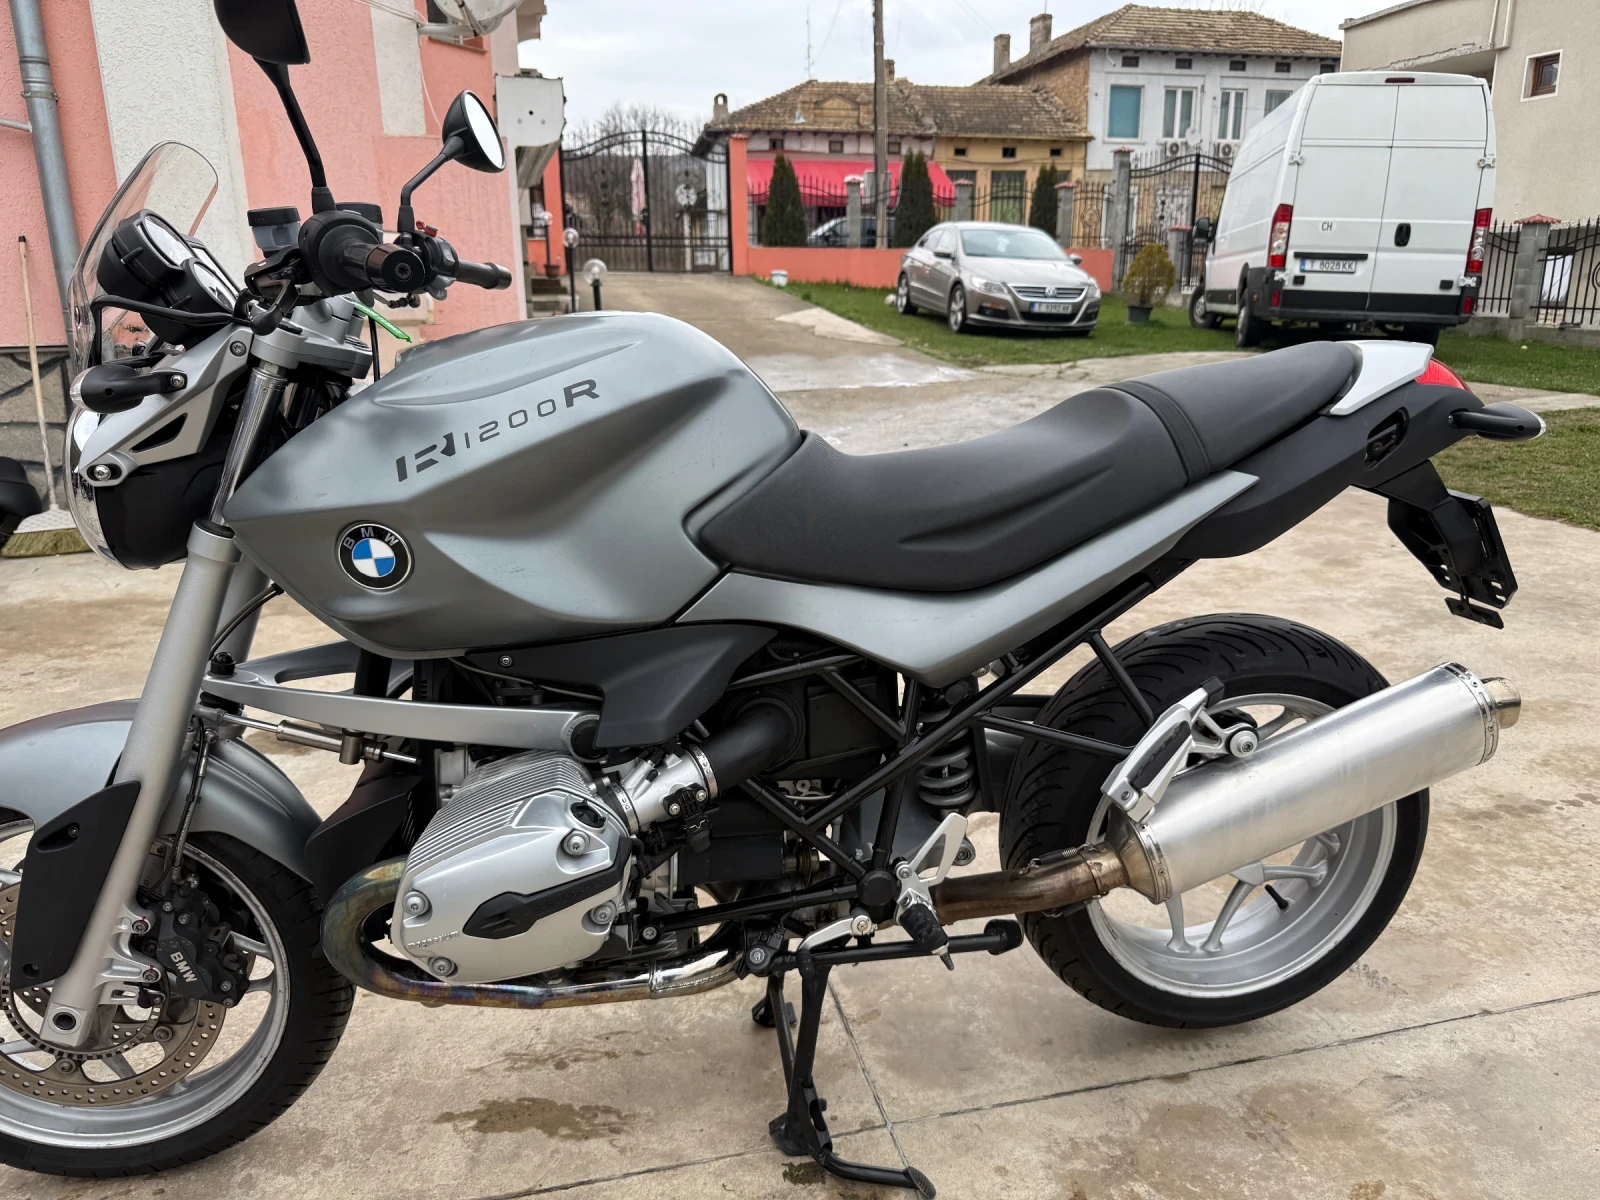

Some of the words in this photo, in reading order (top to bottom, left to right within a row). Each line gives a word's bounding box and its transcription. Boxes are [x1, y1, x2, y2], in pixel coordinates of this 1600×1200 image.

[1321, 221, 1333, 231] CH
[343, 527, 399, 549] BMW
[170, 951, 198, 982] BMW
